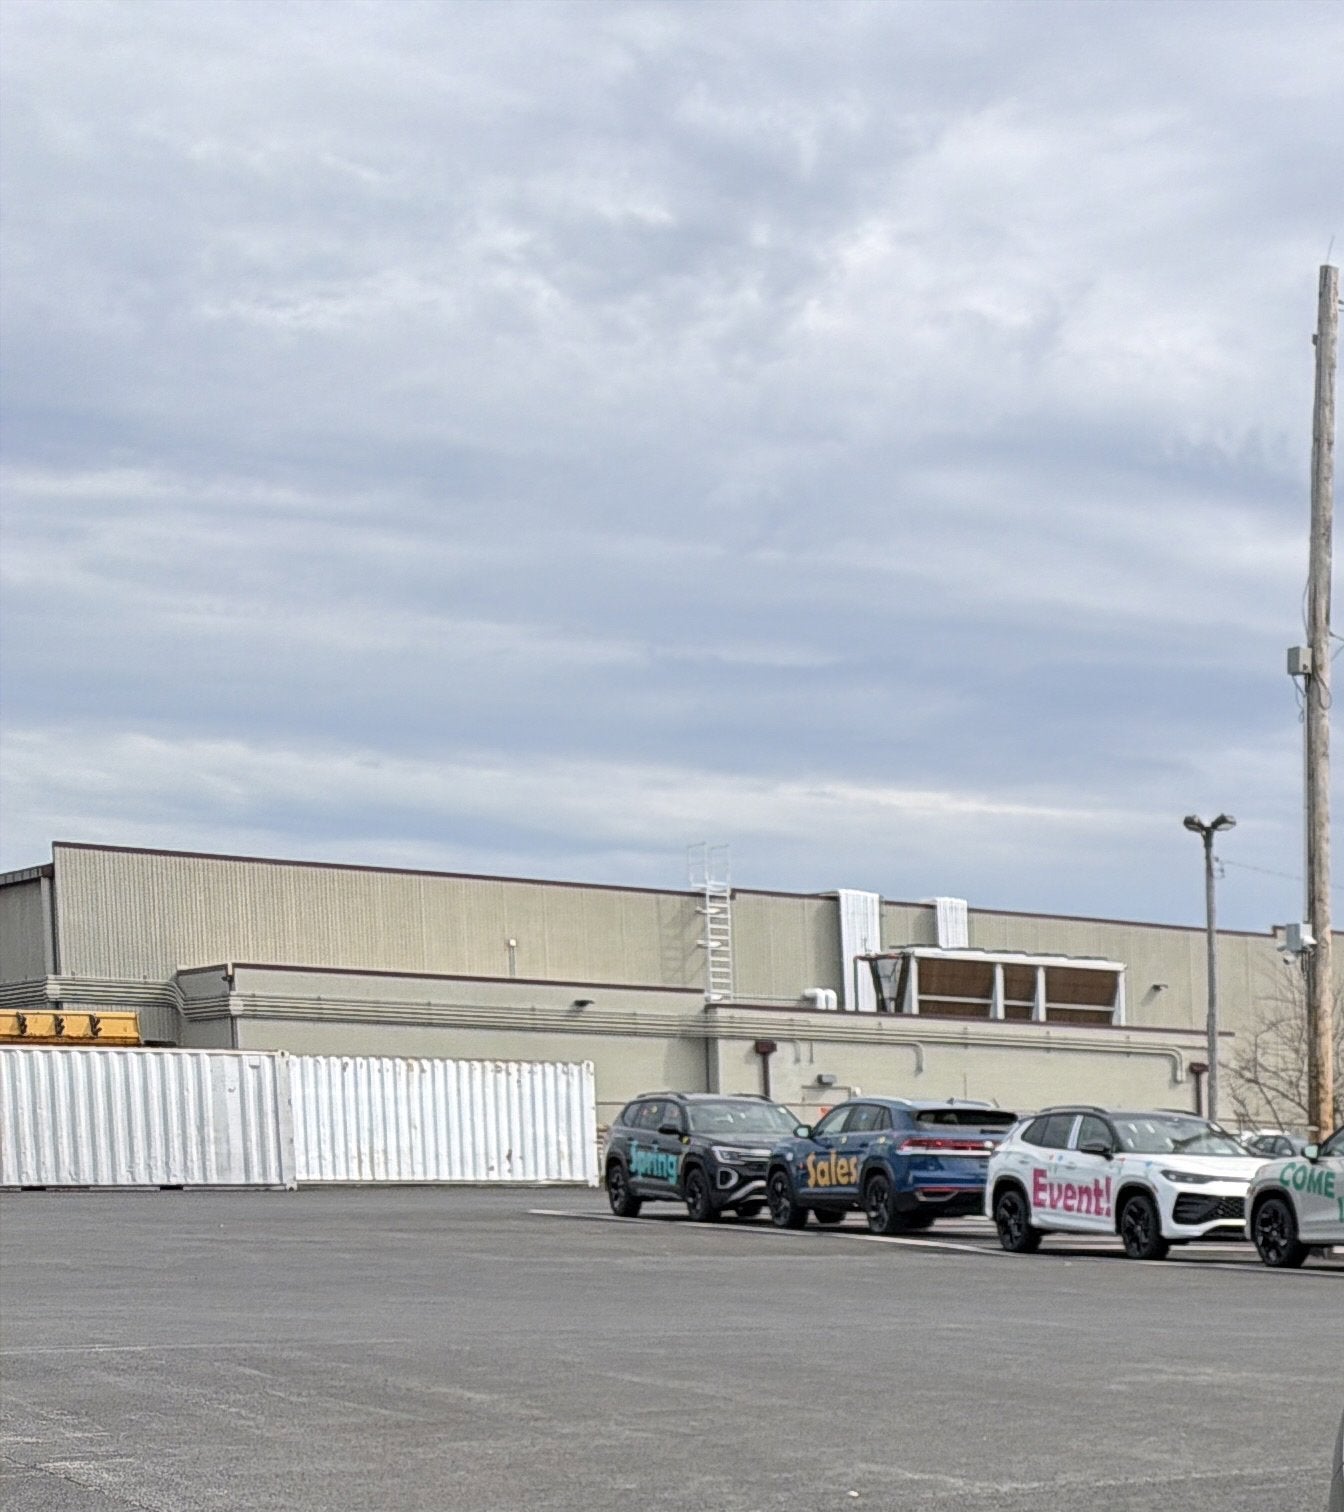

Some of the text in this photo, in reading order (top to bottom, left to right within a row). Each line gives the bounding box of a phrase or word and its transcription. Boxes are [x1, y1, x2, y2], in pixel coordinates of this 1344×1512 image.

[630, 1141, 678, 1185] Spring
[807, 1148, 858, 1188] Sales
[1279, 1162, 1336, 1198] COME
[1033, 1168, 1112, 1217] Event!
